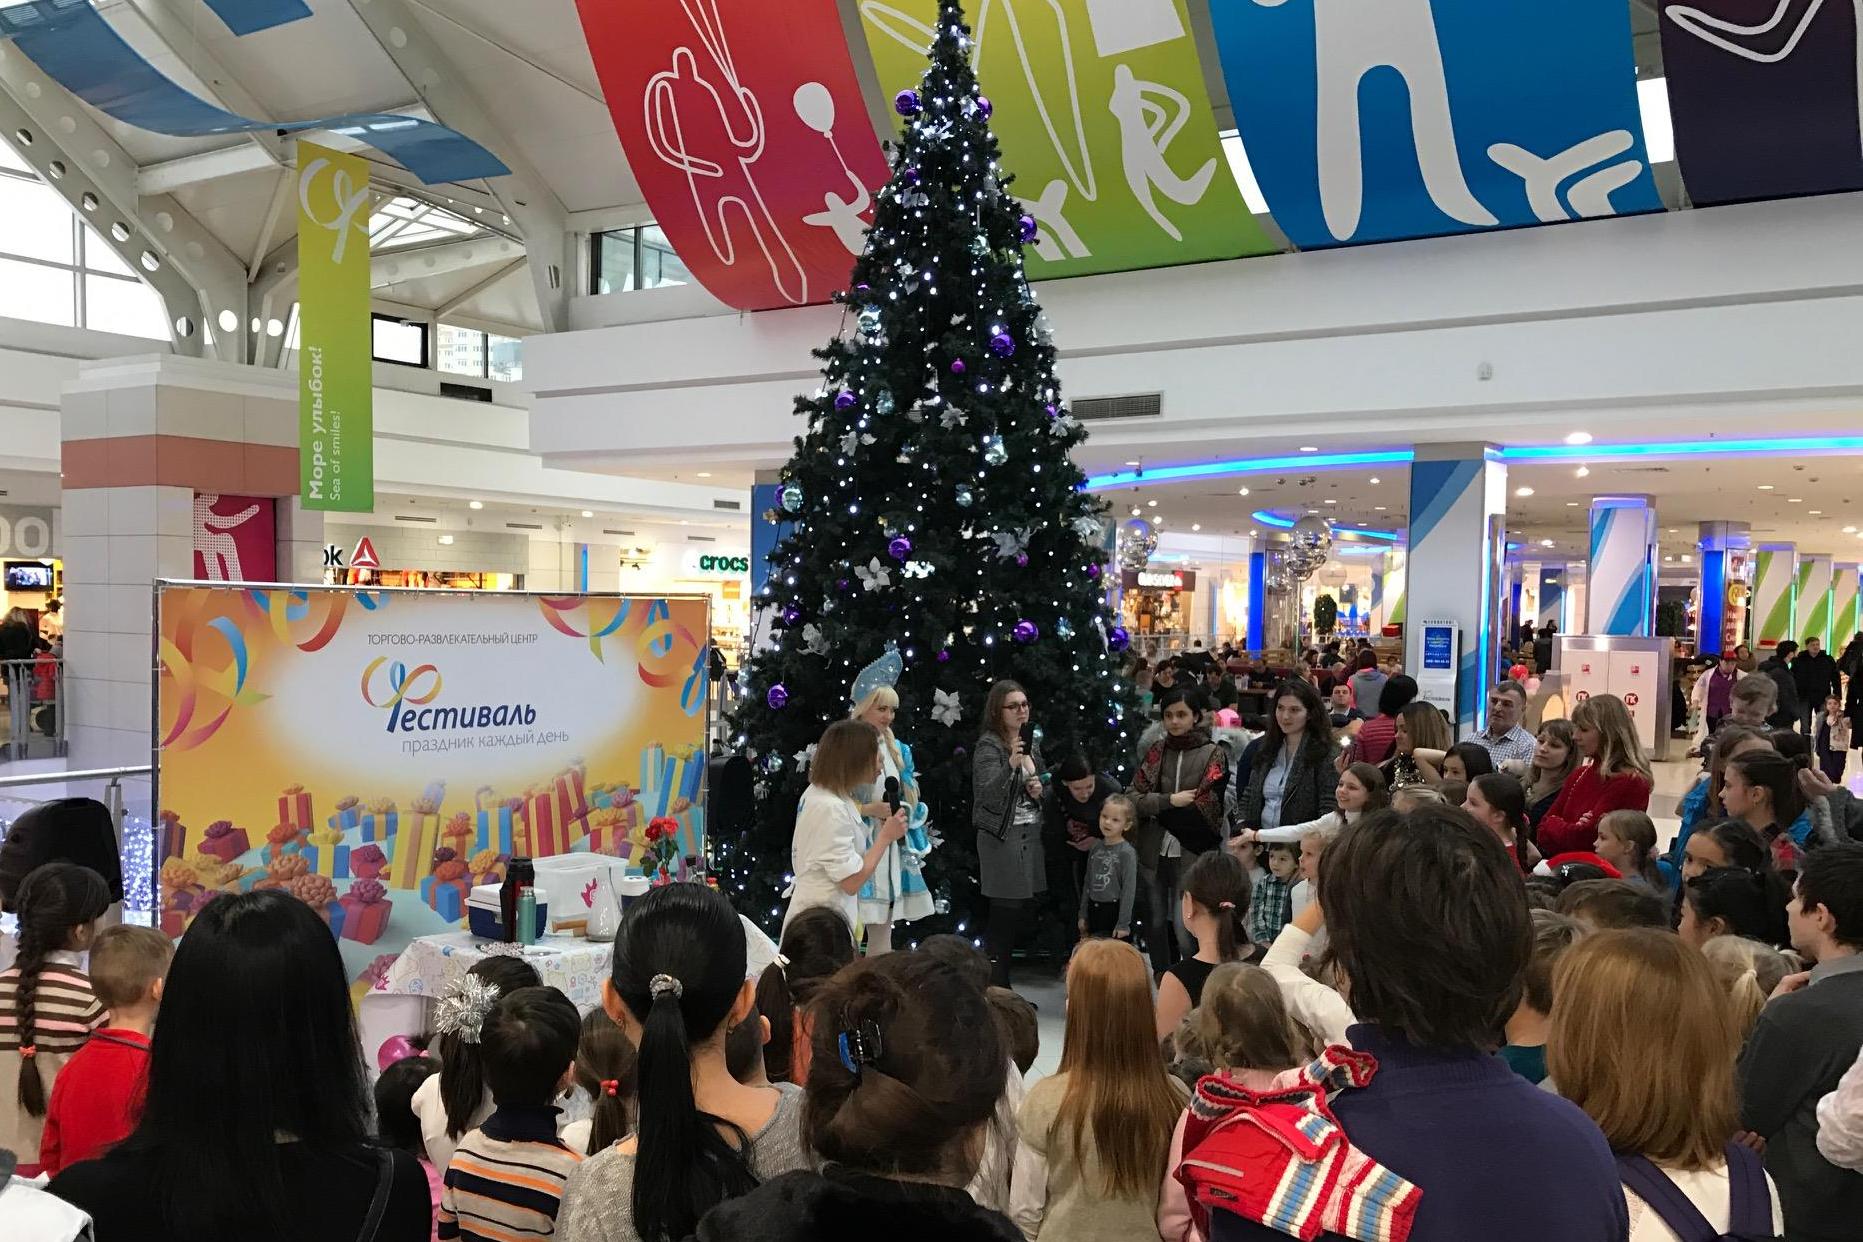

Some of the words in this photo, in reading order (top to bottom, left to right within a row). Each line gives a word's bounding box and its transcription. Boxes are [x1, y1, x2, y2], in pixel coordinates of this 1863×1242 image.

[308, 346, 326, 434] улыбок!
[330, 410, 341, 456] smiles!
[309, 440, 326, 500] Море
[330, 459, 341, 473] of
[330, 478, 341, 501] Sea
[699, 554, 749, 572] crocs
[367, 632, 509, 646] ТОРГОВО-РАЗВЛЕКАТЕЛЬНЫЙ
[510, 633, 538, 647] ЦЕНТР
[360, 655, 537, 734] Фестиваль
[402, 736, 475, 756] праздник
[478, 729, 534, 749] каждый
[537, 730, 570, 746] день
